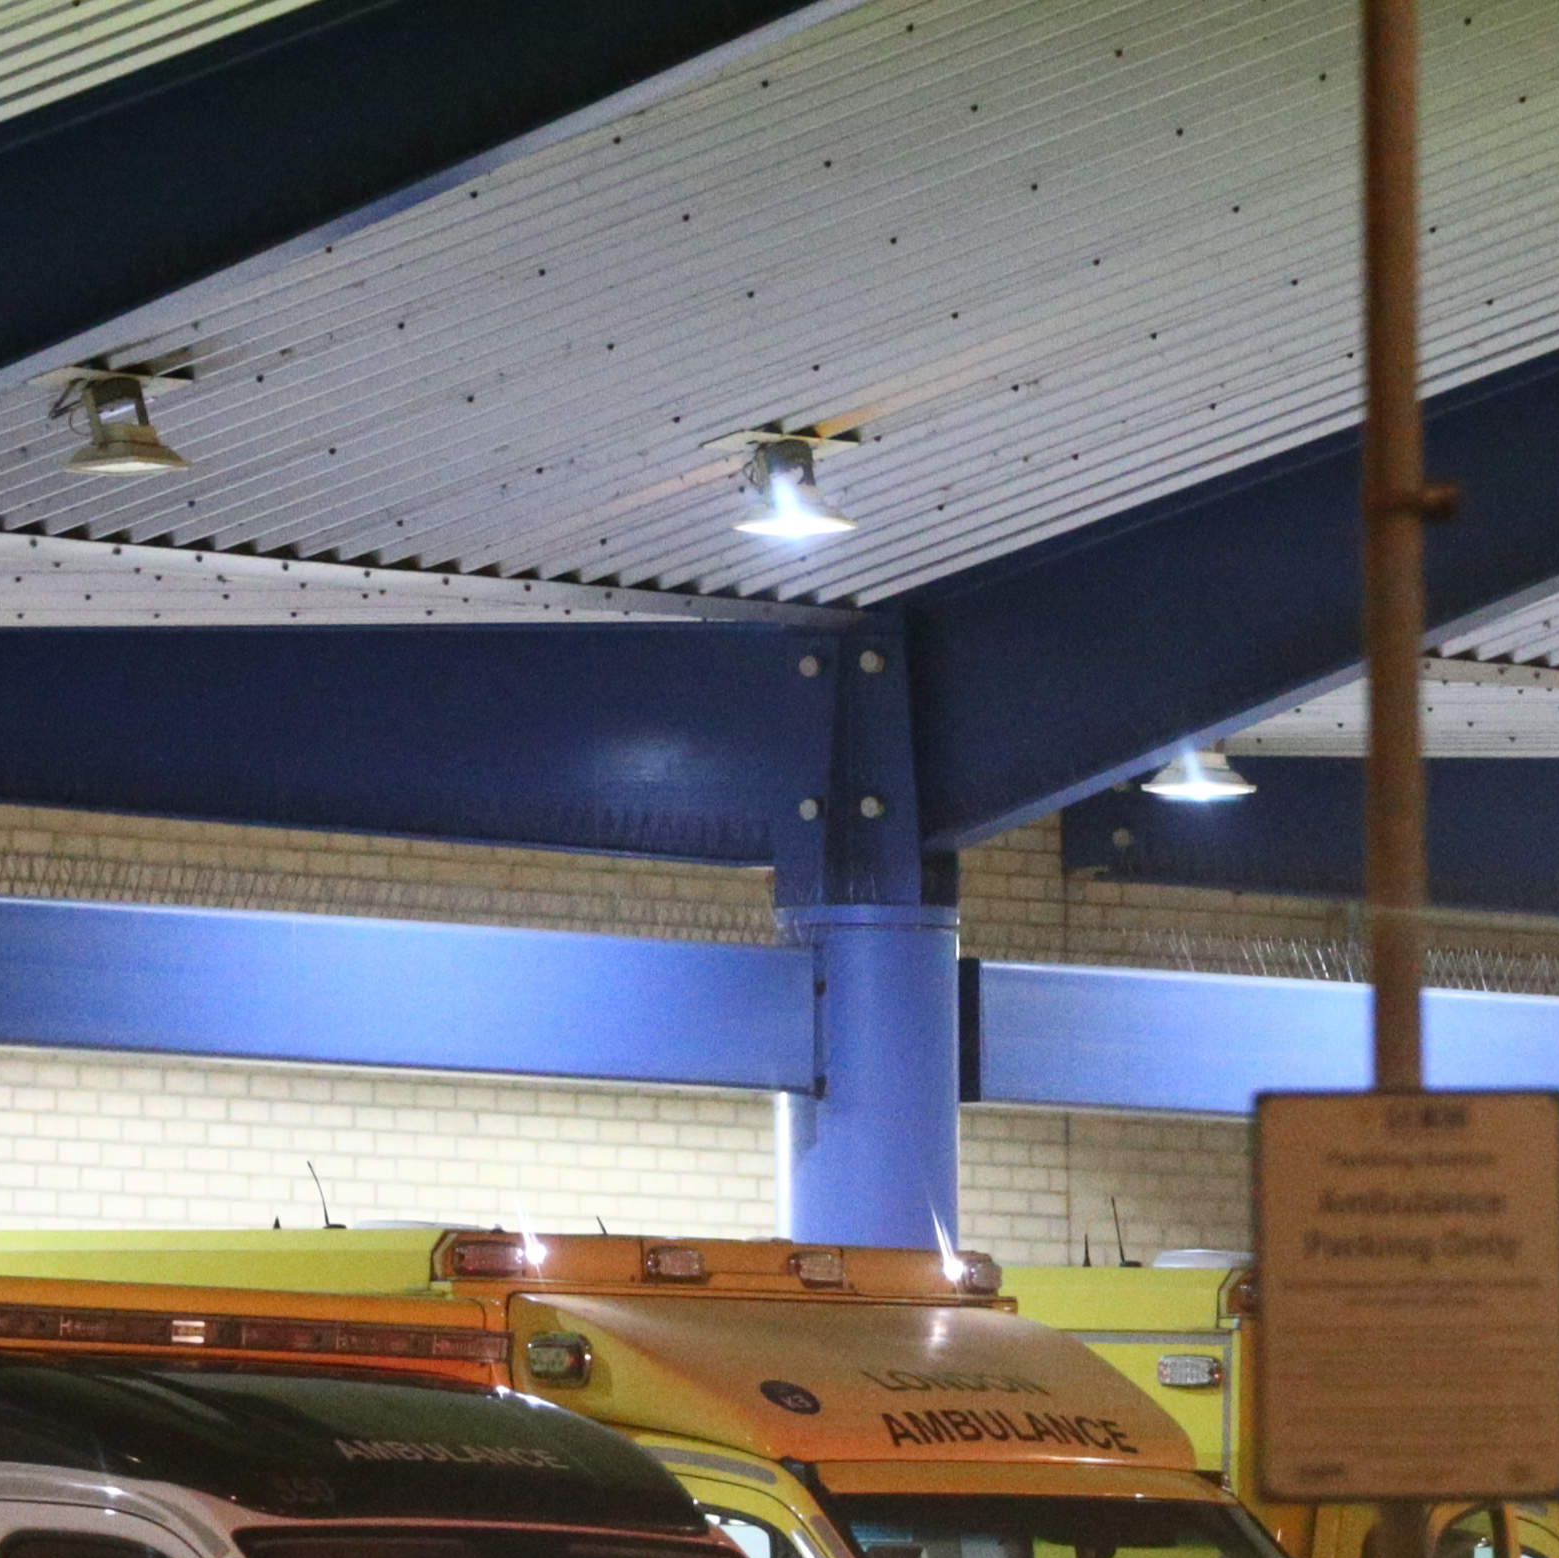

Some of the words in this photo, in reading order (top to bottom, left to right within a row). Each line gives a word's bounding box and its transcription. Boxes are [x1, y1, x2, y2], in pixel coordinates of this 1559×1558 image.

[862, 1370, 1051, 1396] LONDON
[880, 1409, 1138, 1454] AMBULANCE
[333, 1439, 569, 1469] AMBULANCE
